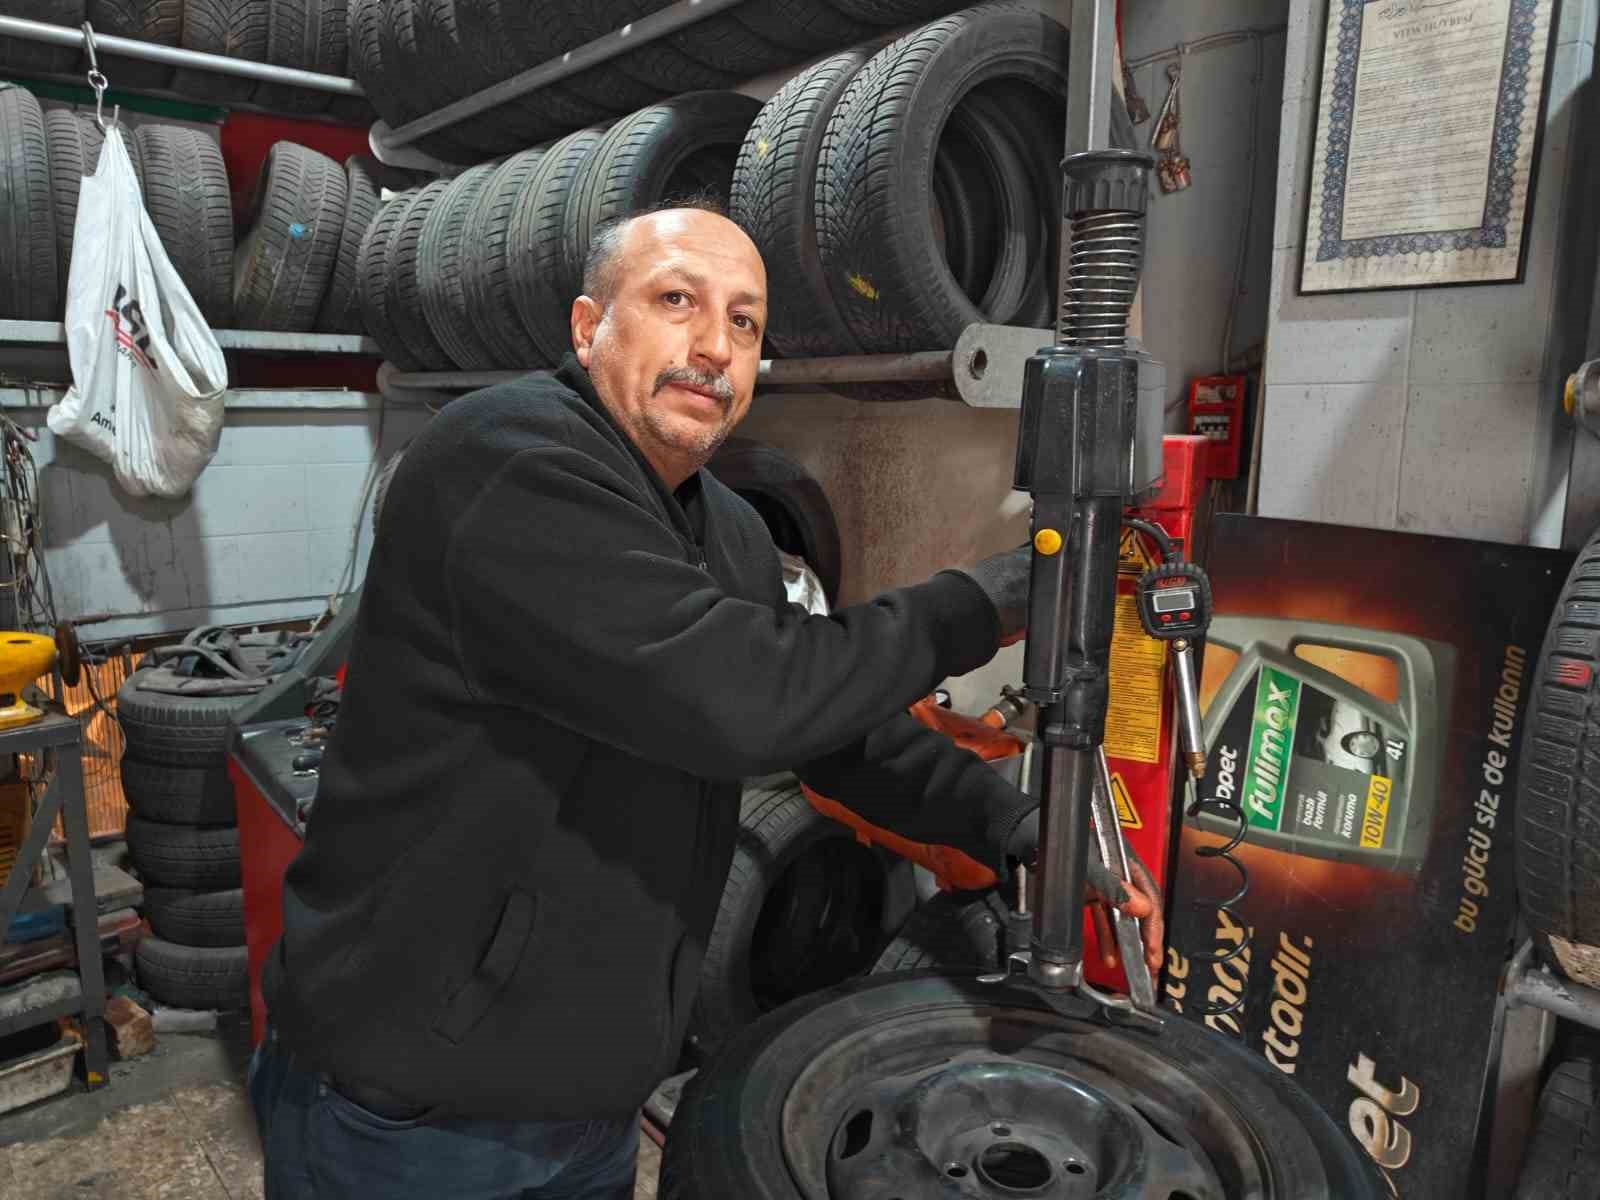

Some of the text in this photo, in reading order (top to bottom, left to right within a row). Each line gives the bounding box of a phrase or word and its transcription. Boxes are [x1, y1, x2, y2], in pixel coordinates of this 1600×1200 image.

[1386, 738, 1404, 761] 4L
[1482, 750, 1507, 785] de
[1341, 793, 1357, 839] koruma
[1363, 780, 1388, 845] 10W-40
[1474, 789, 1500, 829] siz
[1462, 827, 1491, 897] gücü
[1453, 897, 1480, 935] bu
